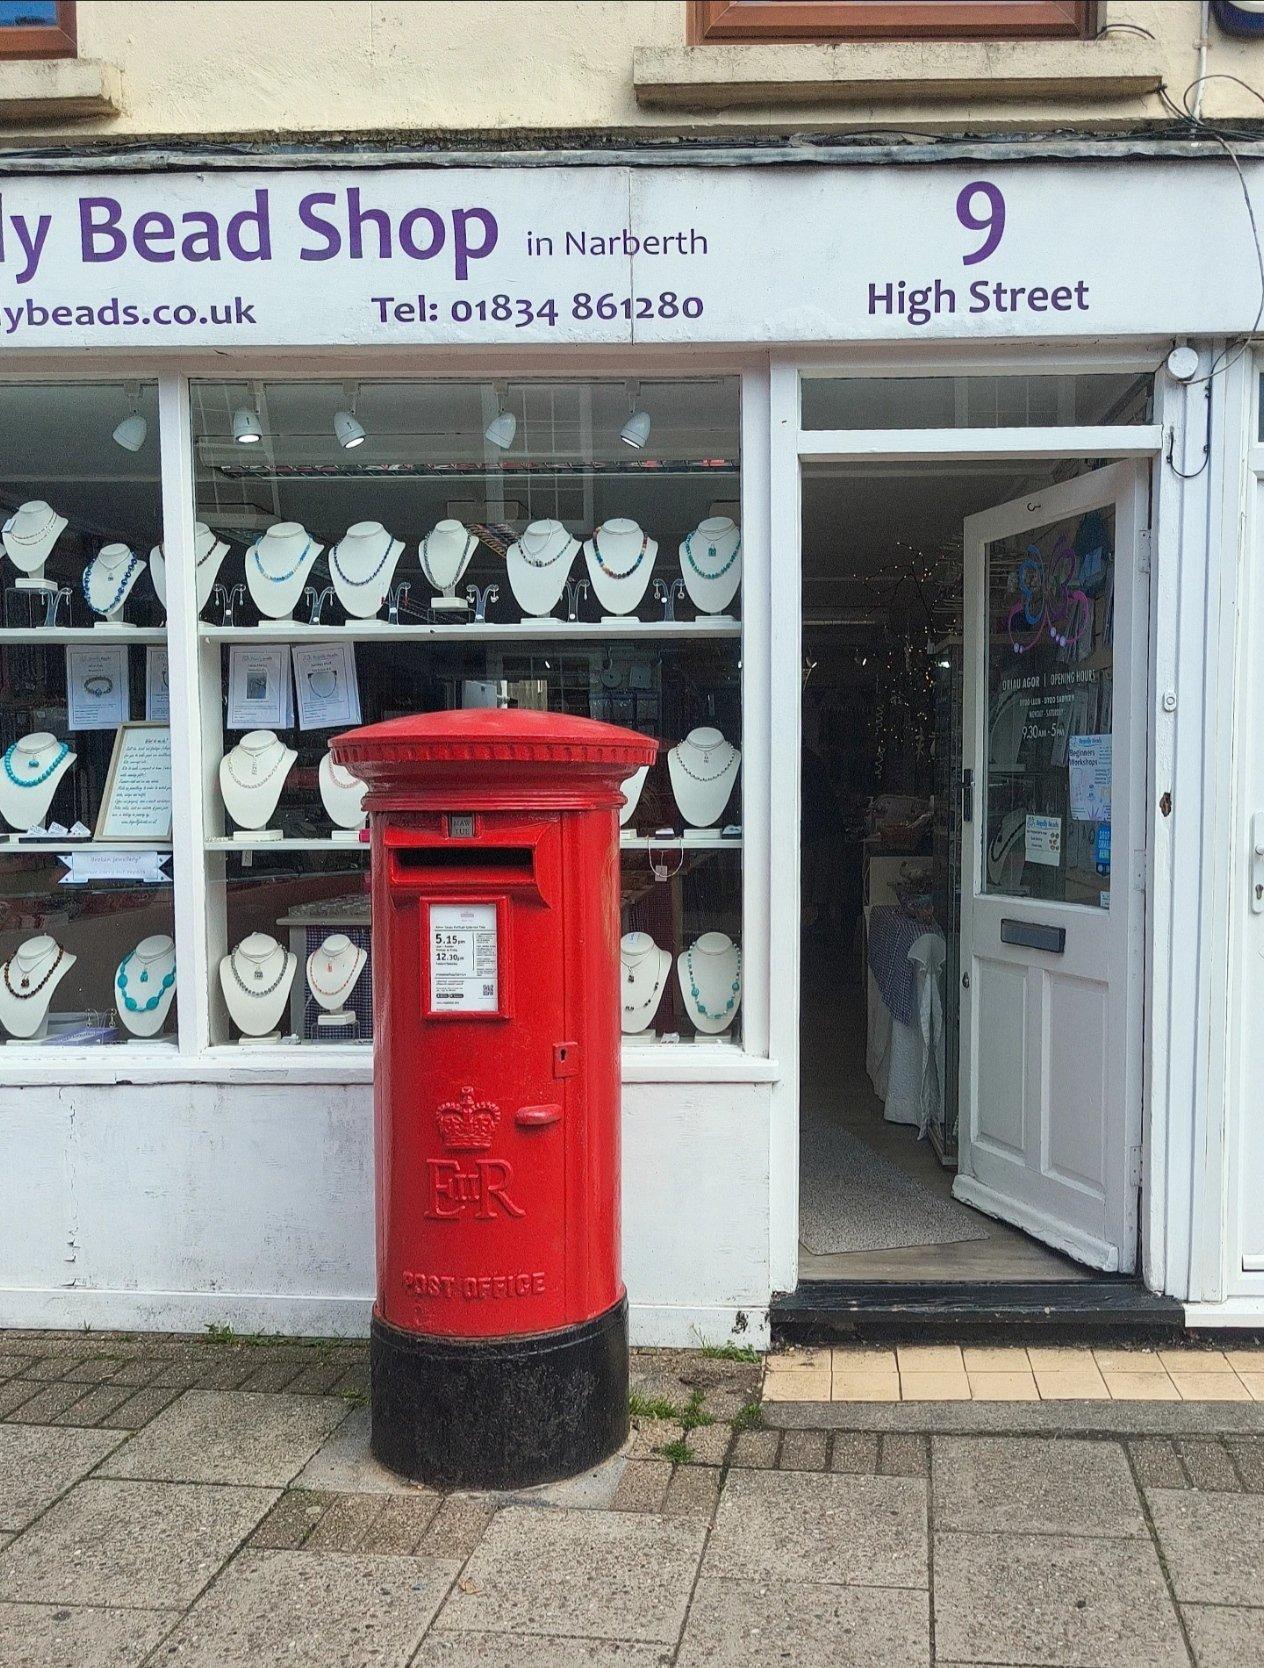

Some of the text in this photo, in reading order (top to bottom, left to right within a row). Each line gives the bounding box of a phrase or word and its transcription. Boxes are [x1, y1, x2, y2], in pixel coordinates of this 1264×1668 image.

[79, 189, 271, 262] Bead
[299, 187, 498, 280] Shop
[954, 181, 1006, 265] 9
[528, 229, 707, 256] in Narberth
[371, 292, 704, 327] Tel: 01834 861280
[868, 279, 1089, 325] High Street
[1023, 676, 1040, 688] AGOR
[1076, 669, 1096, 683] HOURS
[402, 1270, 546, 1298] POST OFFICE
